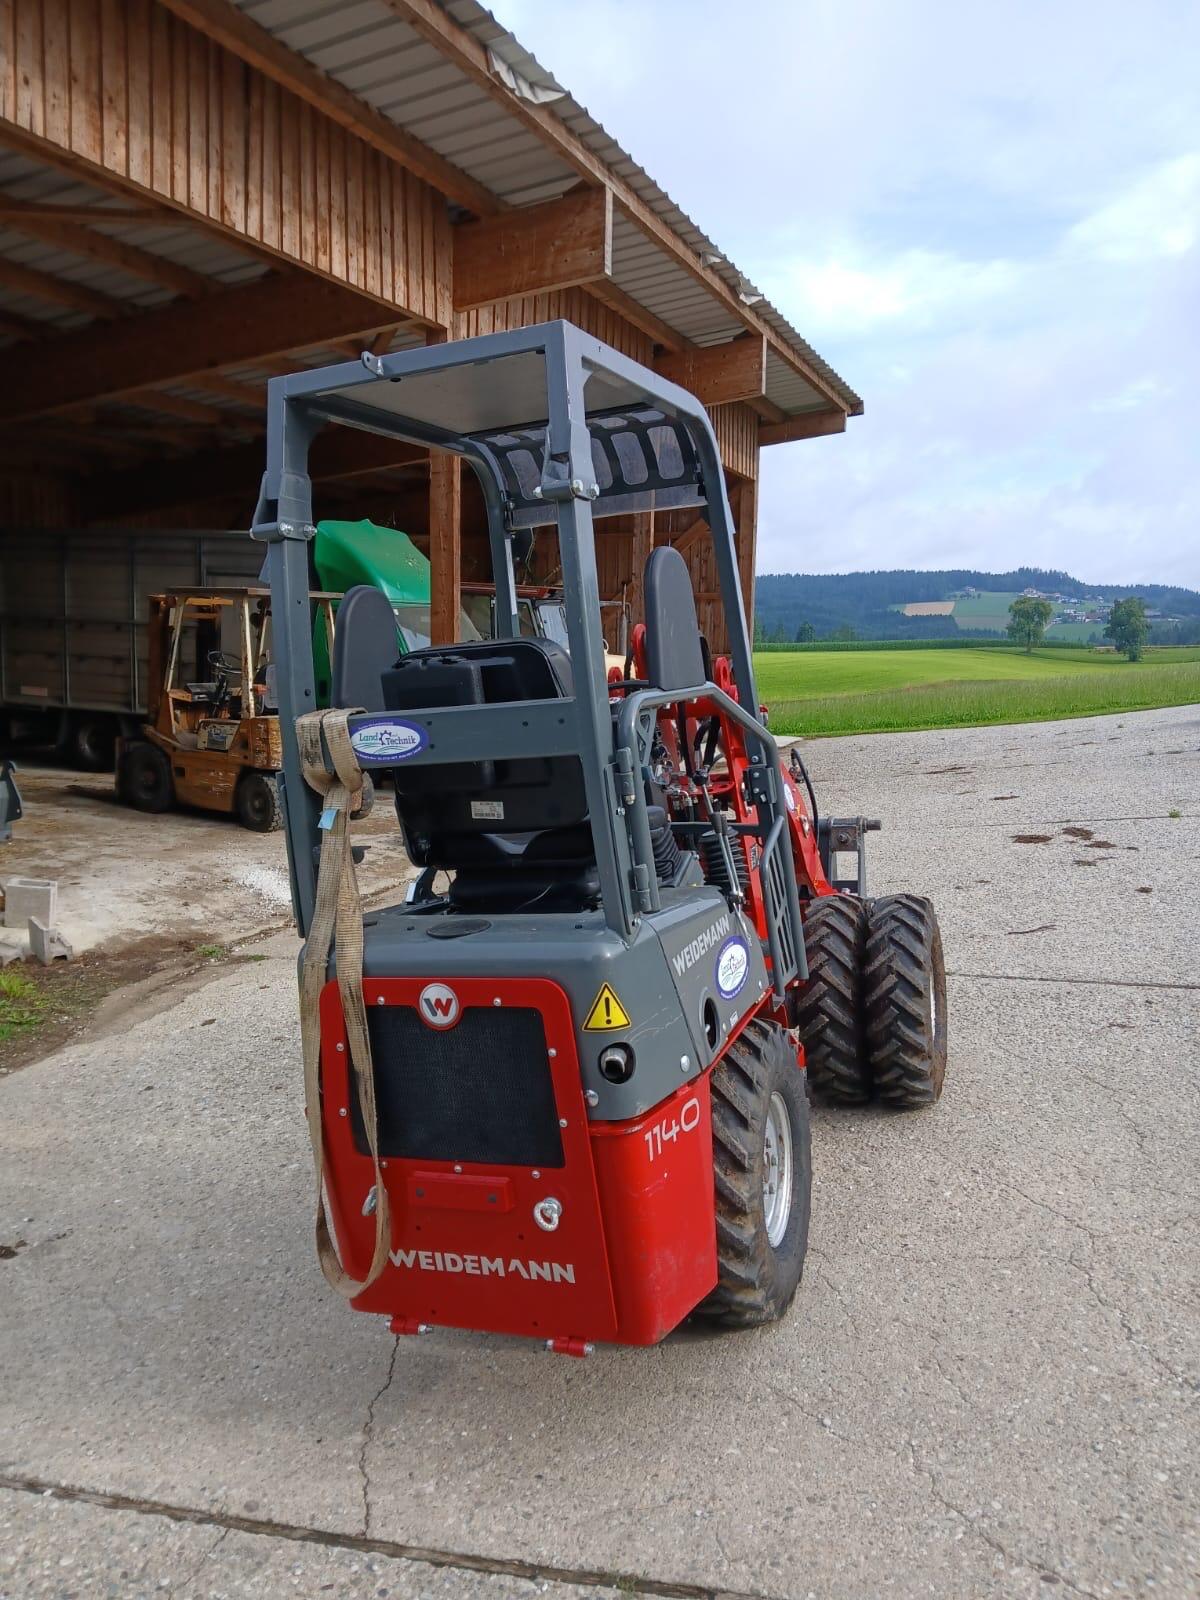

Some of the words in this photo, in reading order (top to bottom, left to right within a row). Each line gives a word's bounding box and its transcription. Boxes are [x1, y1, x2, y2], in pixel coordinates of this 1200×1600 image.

[359, 732, 379, 742] Land
[385, 735, 417, 746] Technik
[672, 914, 730, 977] WEIDEMANN
[644, 1097, 700, 1162] 1140
[388, 1249, 576, 1284] WEIDEMANN
